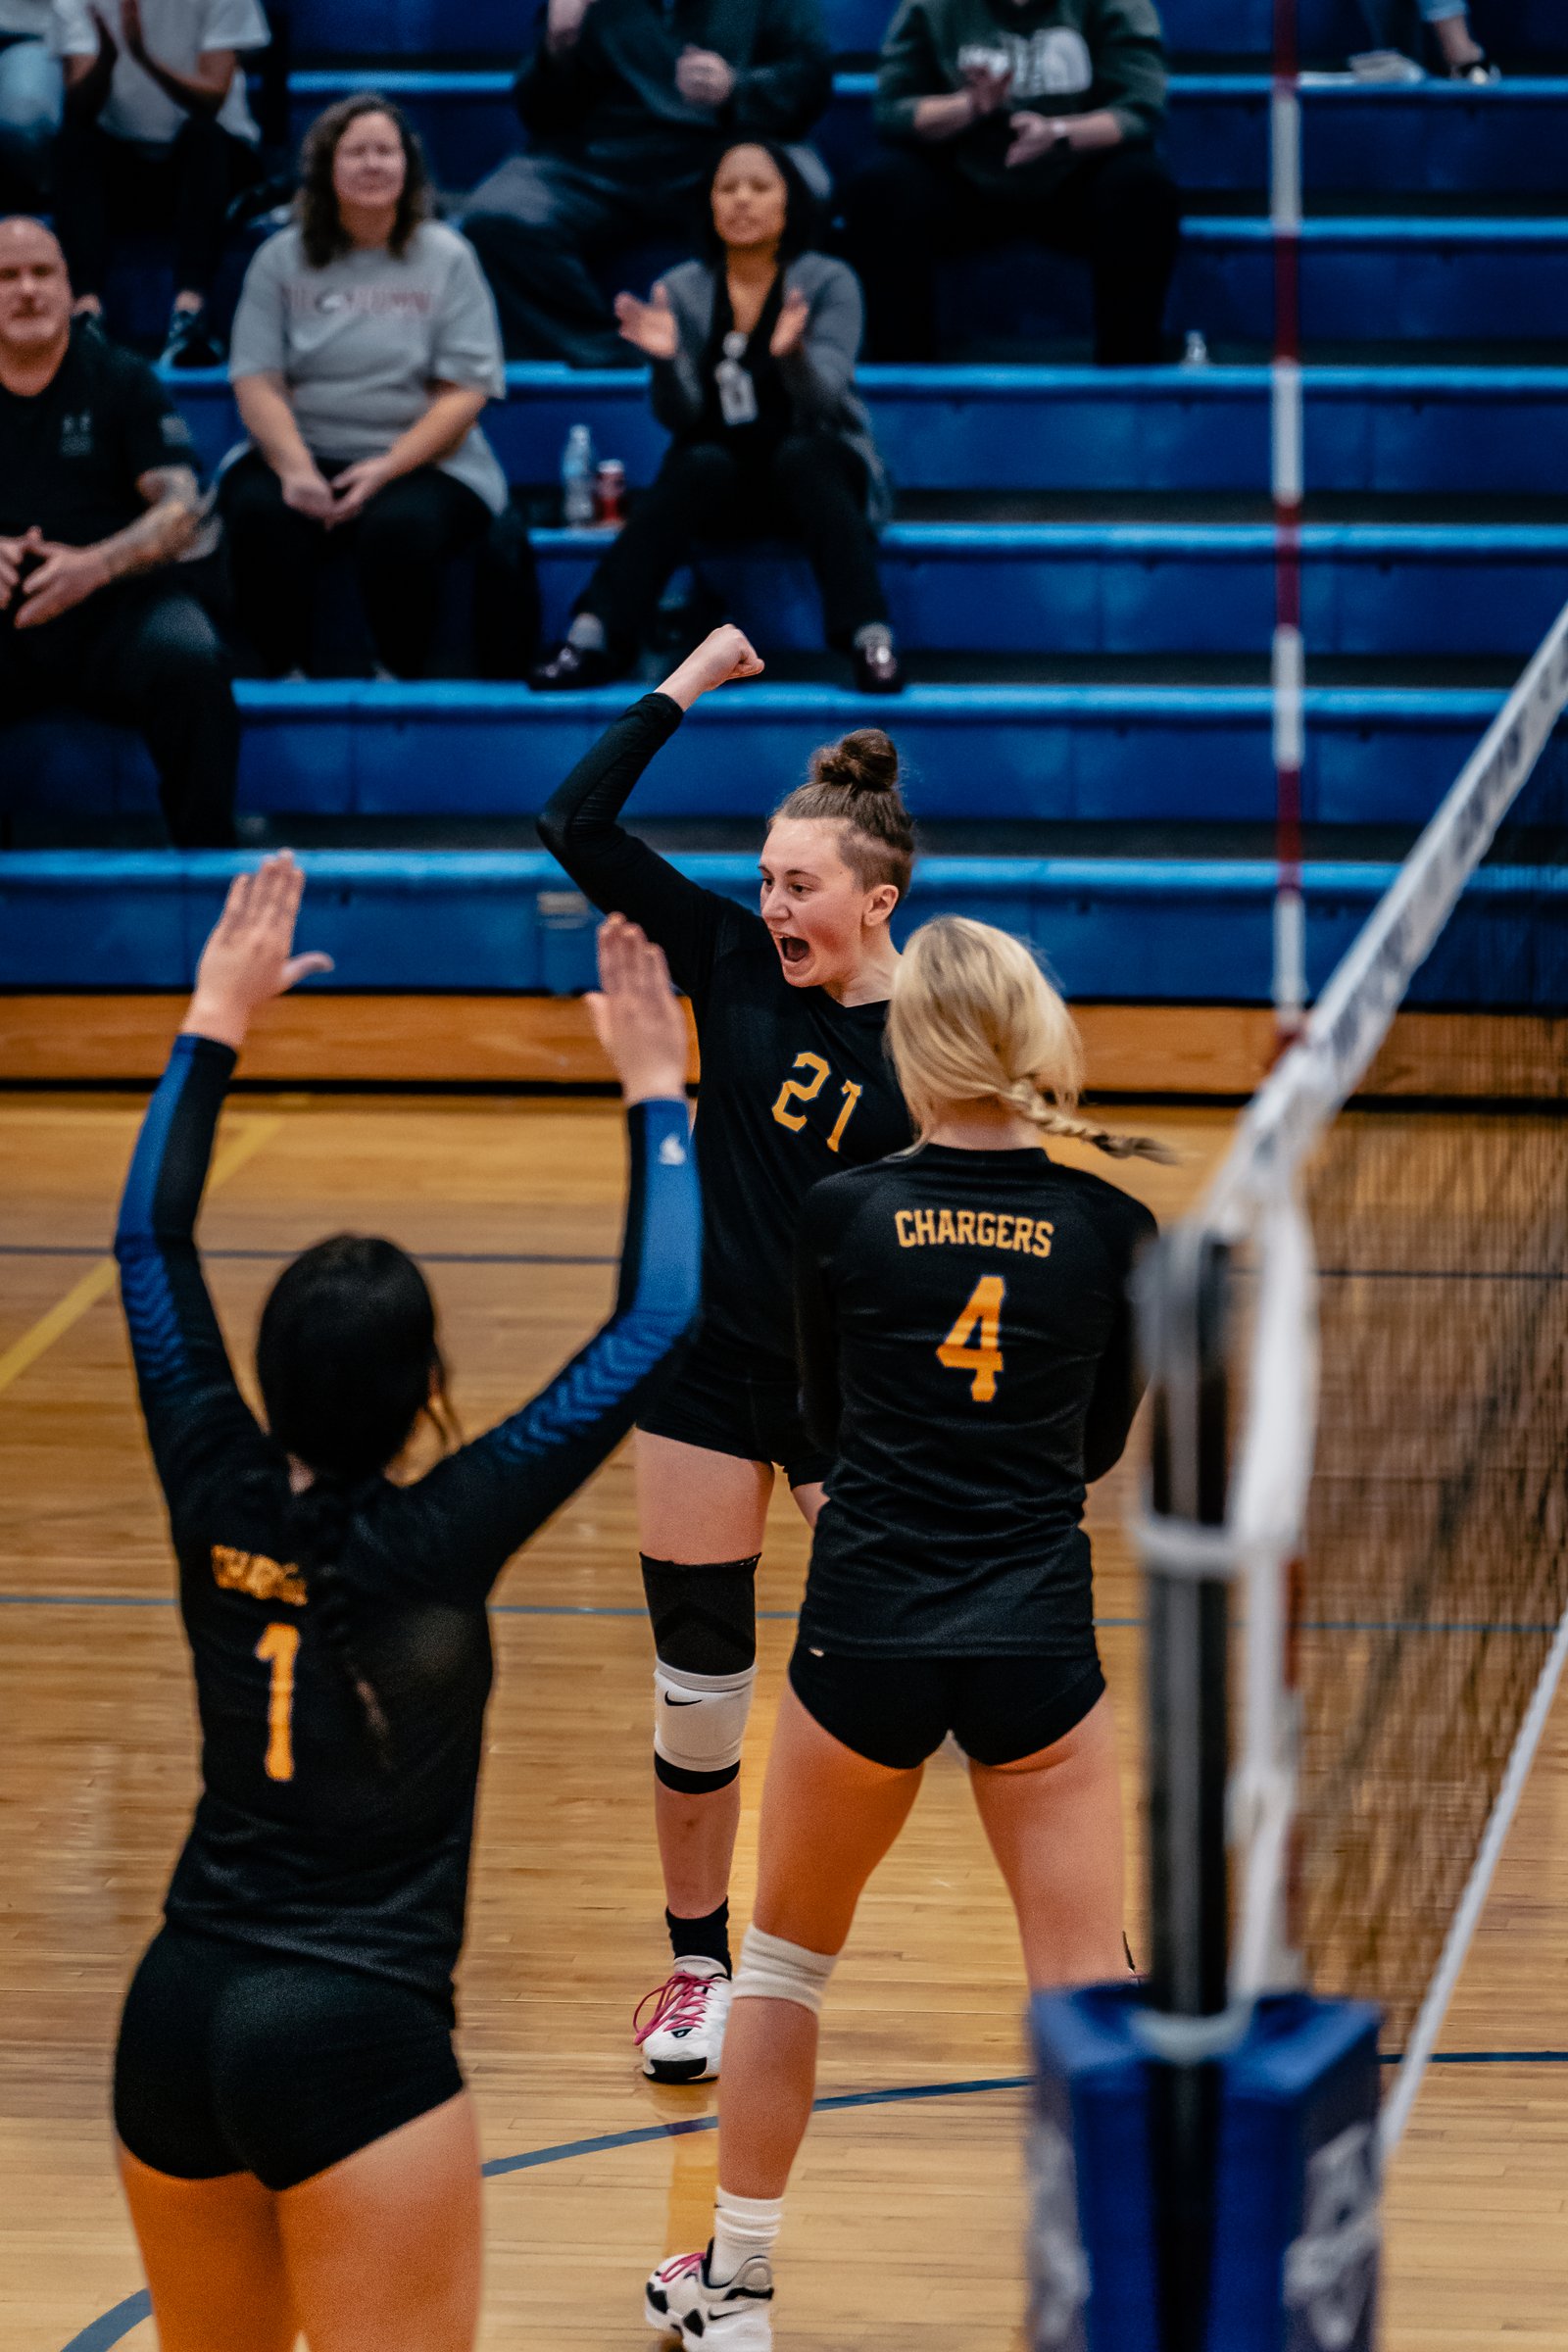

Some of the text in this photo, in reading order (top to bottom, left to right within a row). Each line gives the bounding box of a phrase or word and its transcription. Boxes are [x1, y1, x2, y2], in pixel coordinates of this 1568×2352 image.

[770, 1051, 862, 1153] 21
[894, 1208, 1054, 1258] CHARGERS
[936, 1275, 1005, 1403] 4
[256, 1622, 299, 1782] 1
